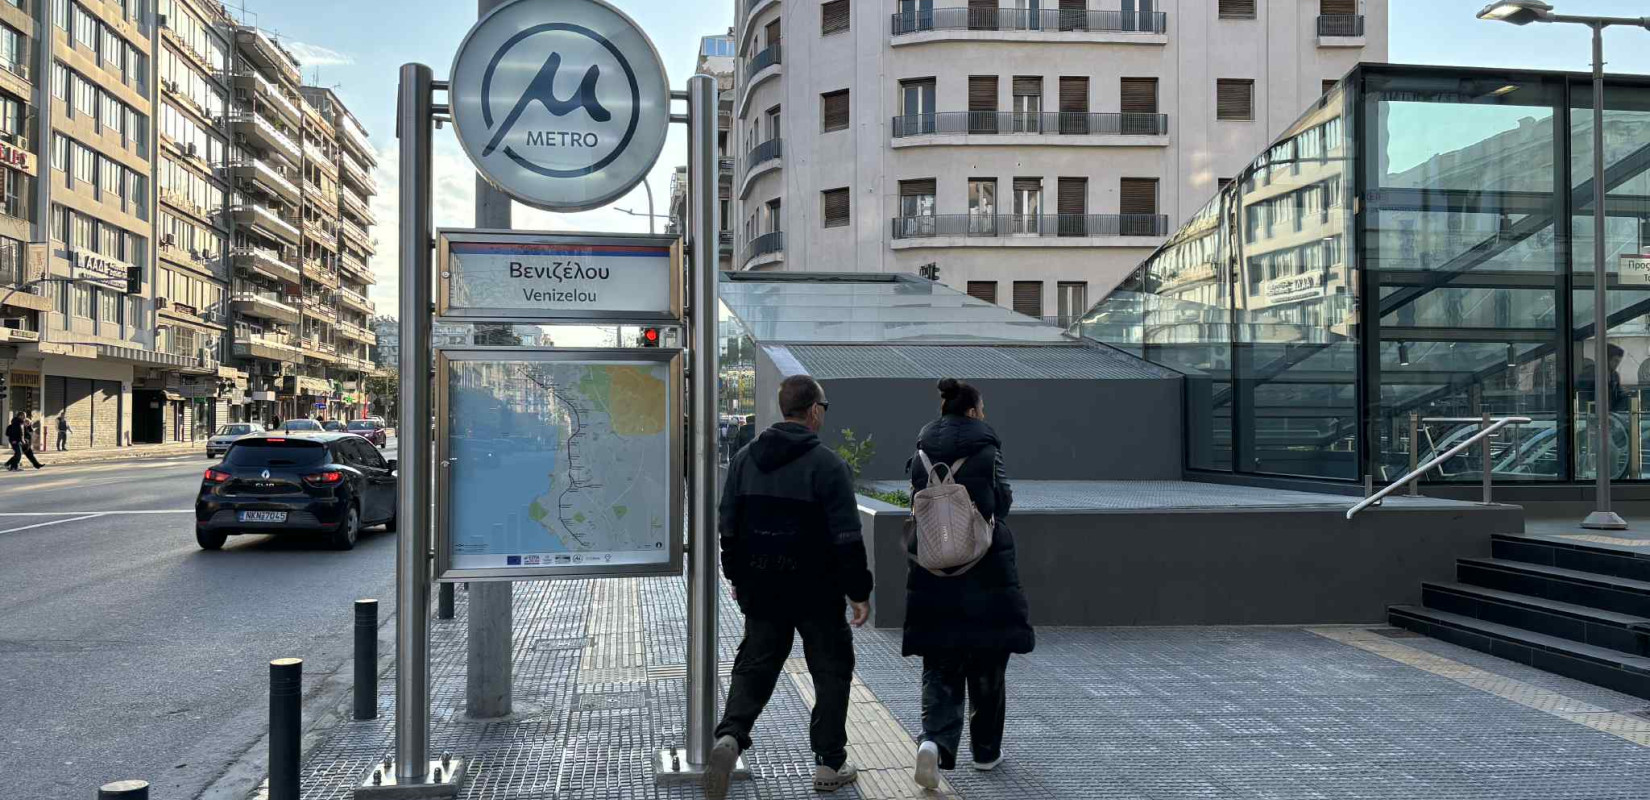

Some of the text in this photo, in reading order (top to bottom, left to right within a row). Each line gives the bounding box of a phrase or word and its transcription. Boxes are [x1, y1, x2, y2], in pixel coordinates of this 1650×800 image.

[526, 131, 598, 147] METRO
[510, 261, 609, 282] Βενιζέλου
[523, 288, 596, 302] Venizelou
